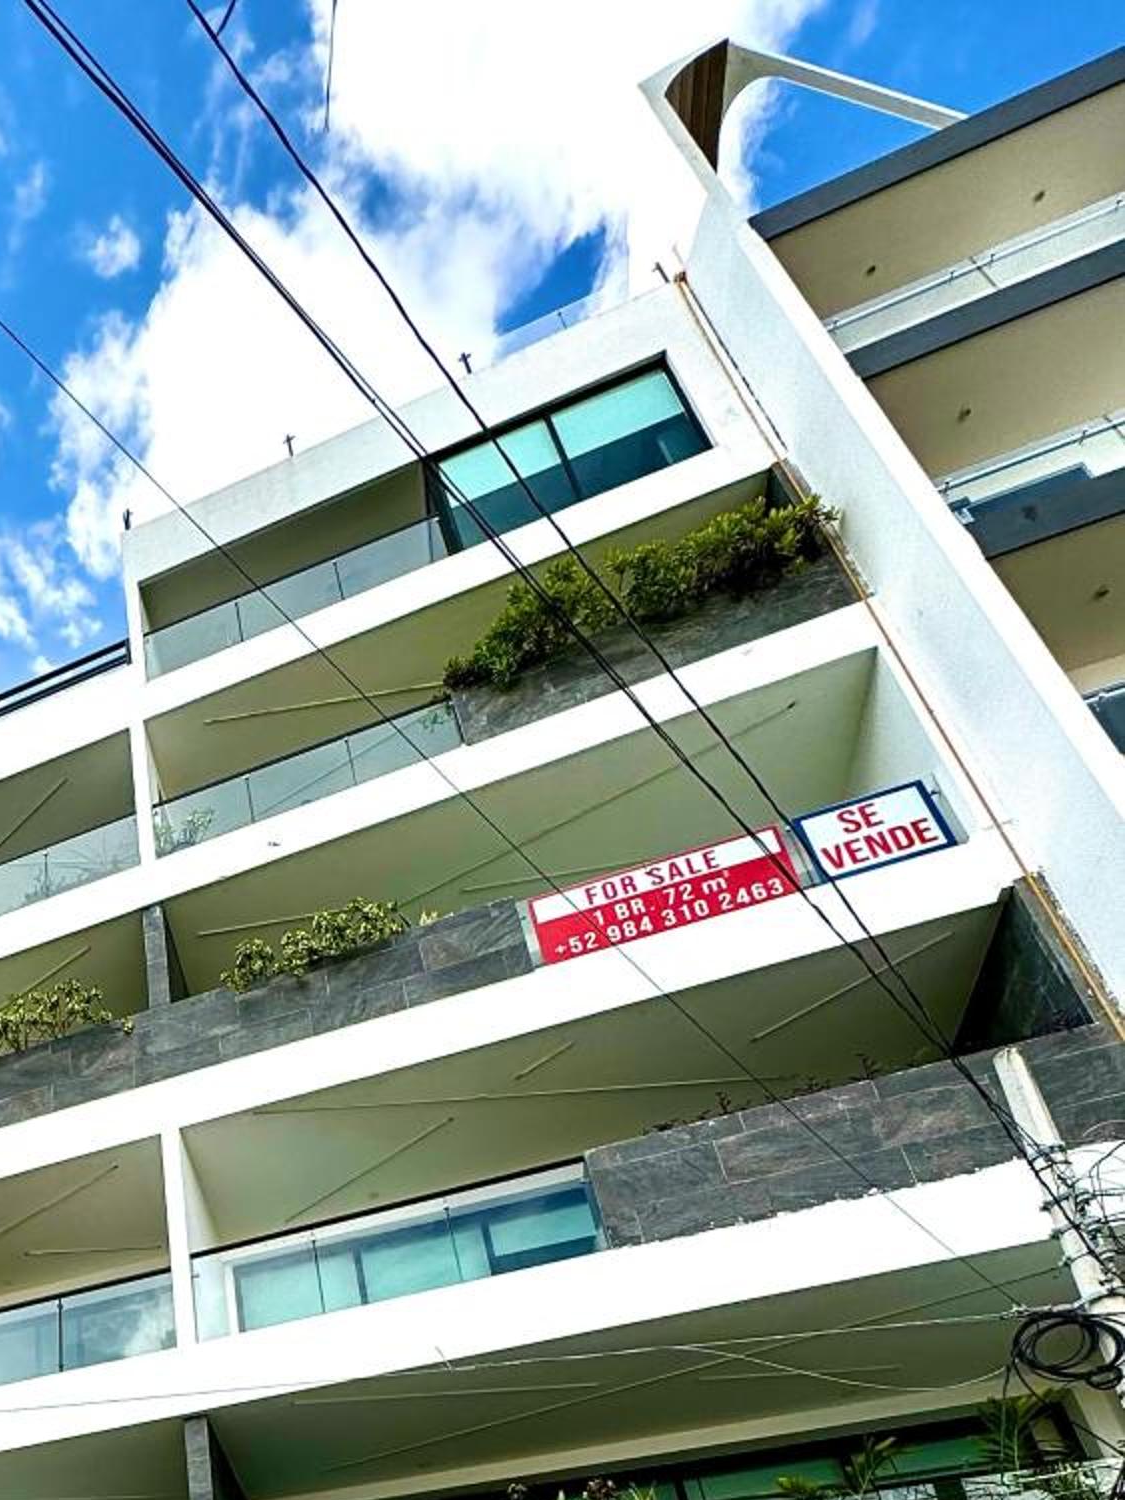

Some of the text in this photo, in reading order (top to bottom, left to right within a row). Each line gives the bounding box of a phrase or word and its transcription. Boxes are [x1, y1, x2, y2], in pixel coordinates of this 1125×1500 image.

[837, 802, 884, 833] SE
[821, 818, 938, 870] VENDE
[584, 850, 720, 905] FOR SALE
[555, 877, 784, 955] +52 984 310 2463
[593, 910, 605, 926] 1
[663, 883, 695, 905] 72
